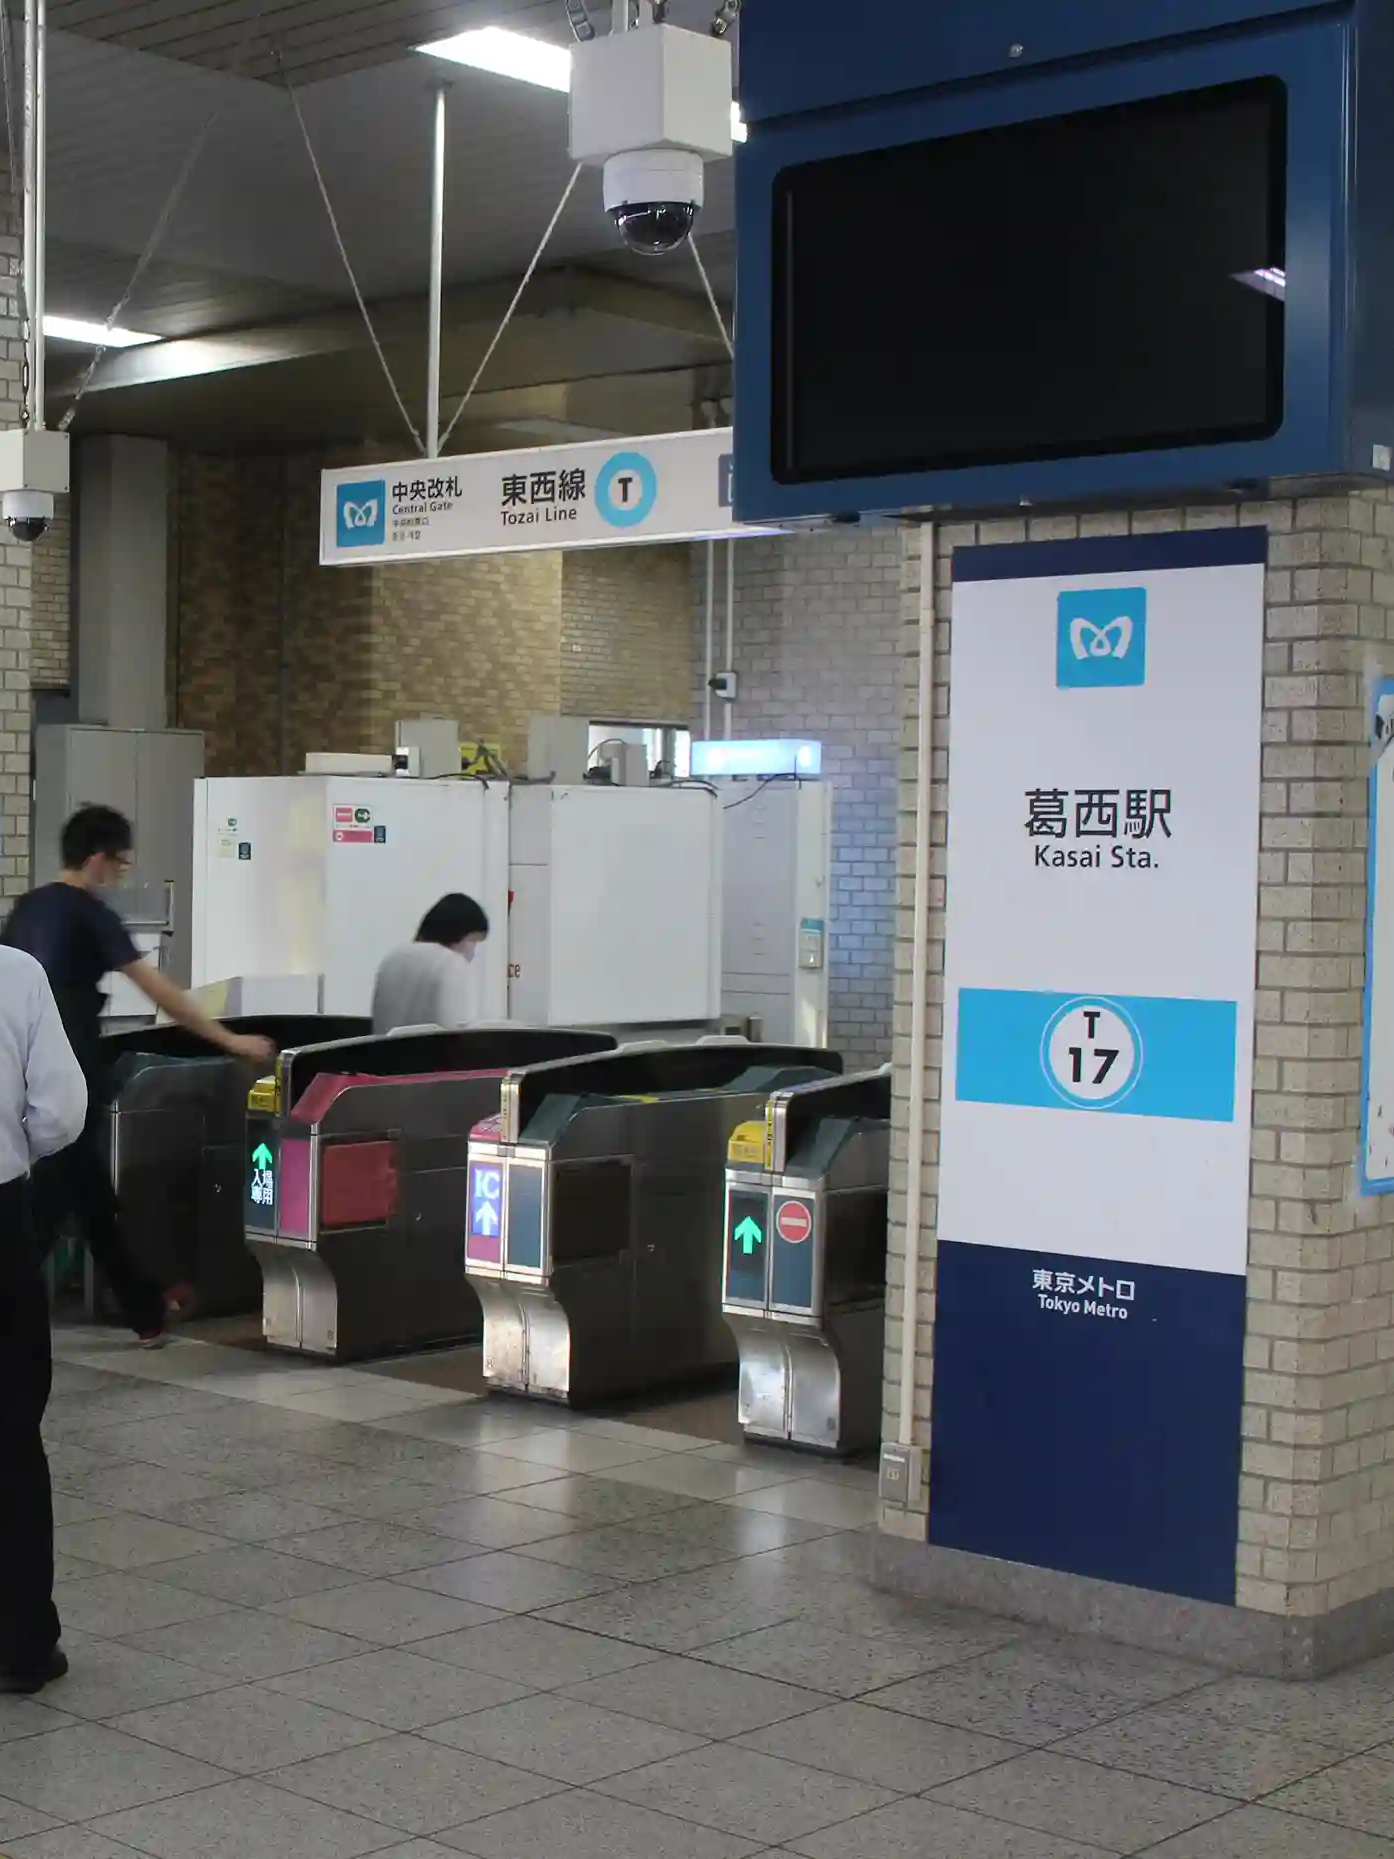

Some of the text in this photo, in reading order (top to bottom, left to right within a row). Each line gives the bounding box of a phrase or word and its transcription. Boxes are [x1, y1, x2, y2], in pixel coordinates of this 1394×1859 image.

[392, 476, 462, 502] 中央改札
[502, 468, 586, 506] 東西線
[617, 477, 633, 503] T
[392, 501, 453, 514] Central Gate
[501, 506, 577, 525] Tozai Line
[1024, 788, 1172, 839] 葛西駅
[1035, 845, 1159, 869] Kasai Sta.
[1083, 1011, 1100, 1039] T
[1068, 1047, 1119, 1085] 17
[251, 1169, 273, 1188] 入場
[474, 1168, 500, 1199] IC
[251, 1187, 273, 1205] 専用
[1032, 1269, 1135, 1301] 東京メトロ
[1038, 1294, 1128, 1319] Tokyo Metro
